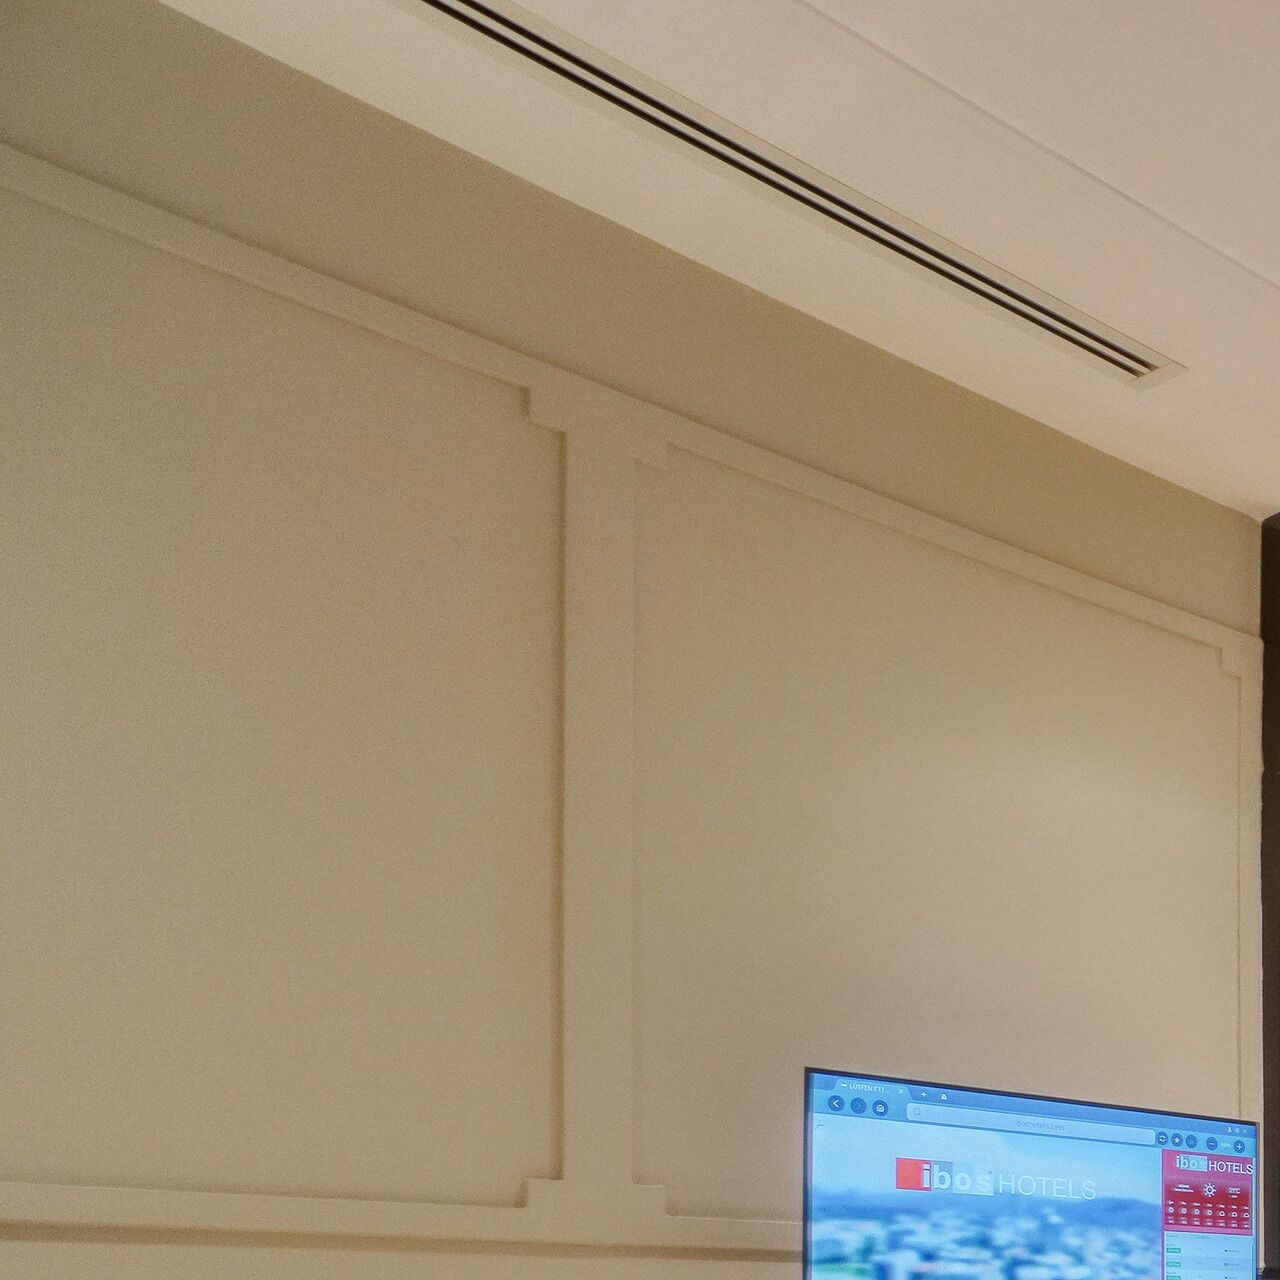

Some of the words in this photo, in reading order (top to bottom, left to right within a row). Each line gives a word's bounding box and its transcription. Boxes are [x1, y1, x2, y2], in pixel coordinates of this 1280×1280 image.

[1208, 1160, 1253, 1174] HOTELS
[922, 1162, 993, 1192] ibos
[999, 1174, 1096, 1200] HOTELS
